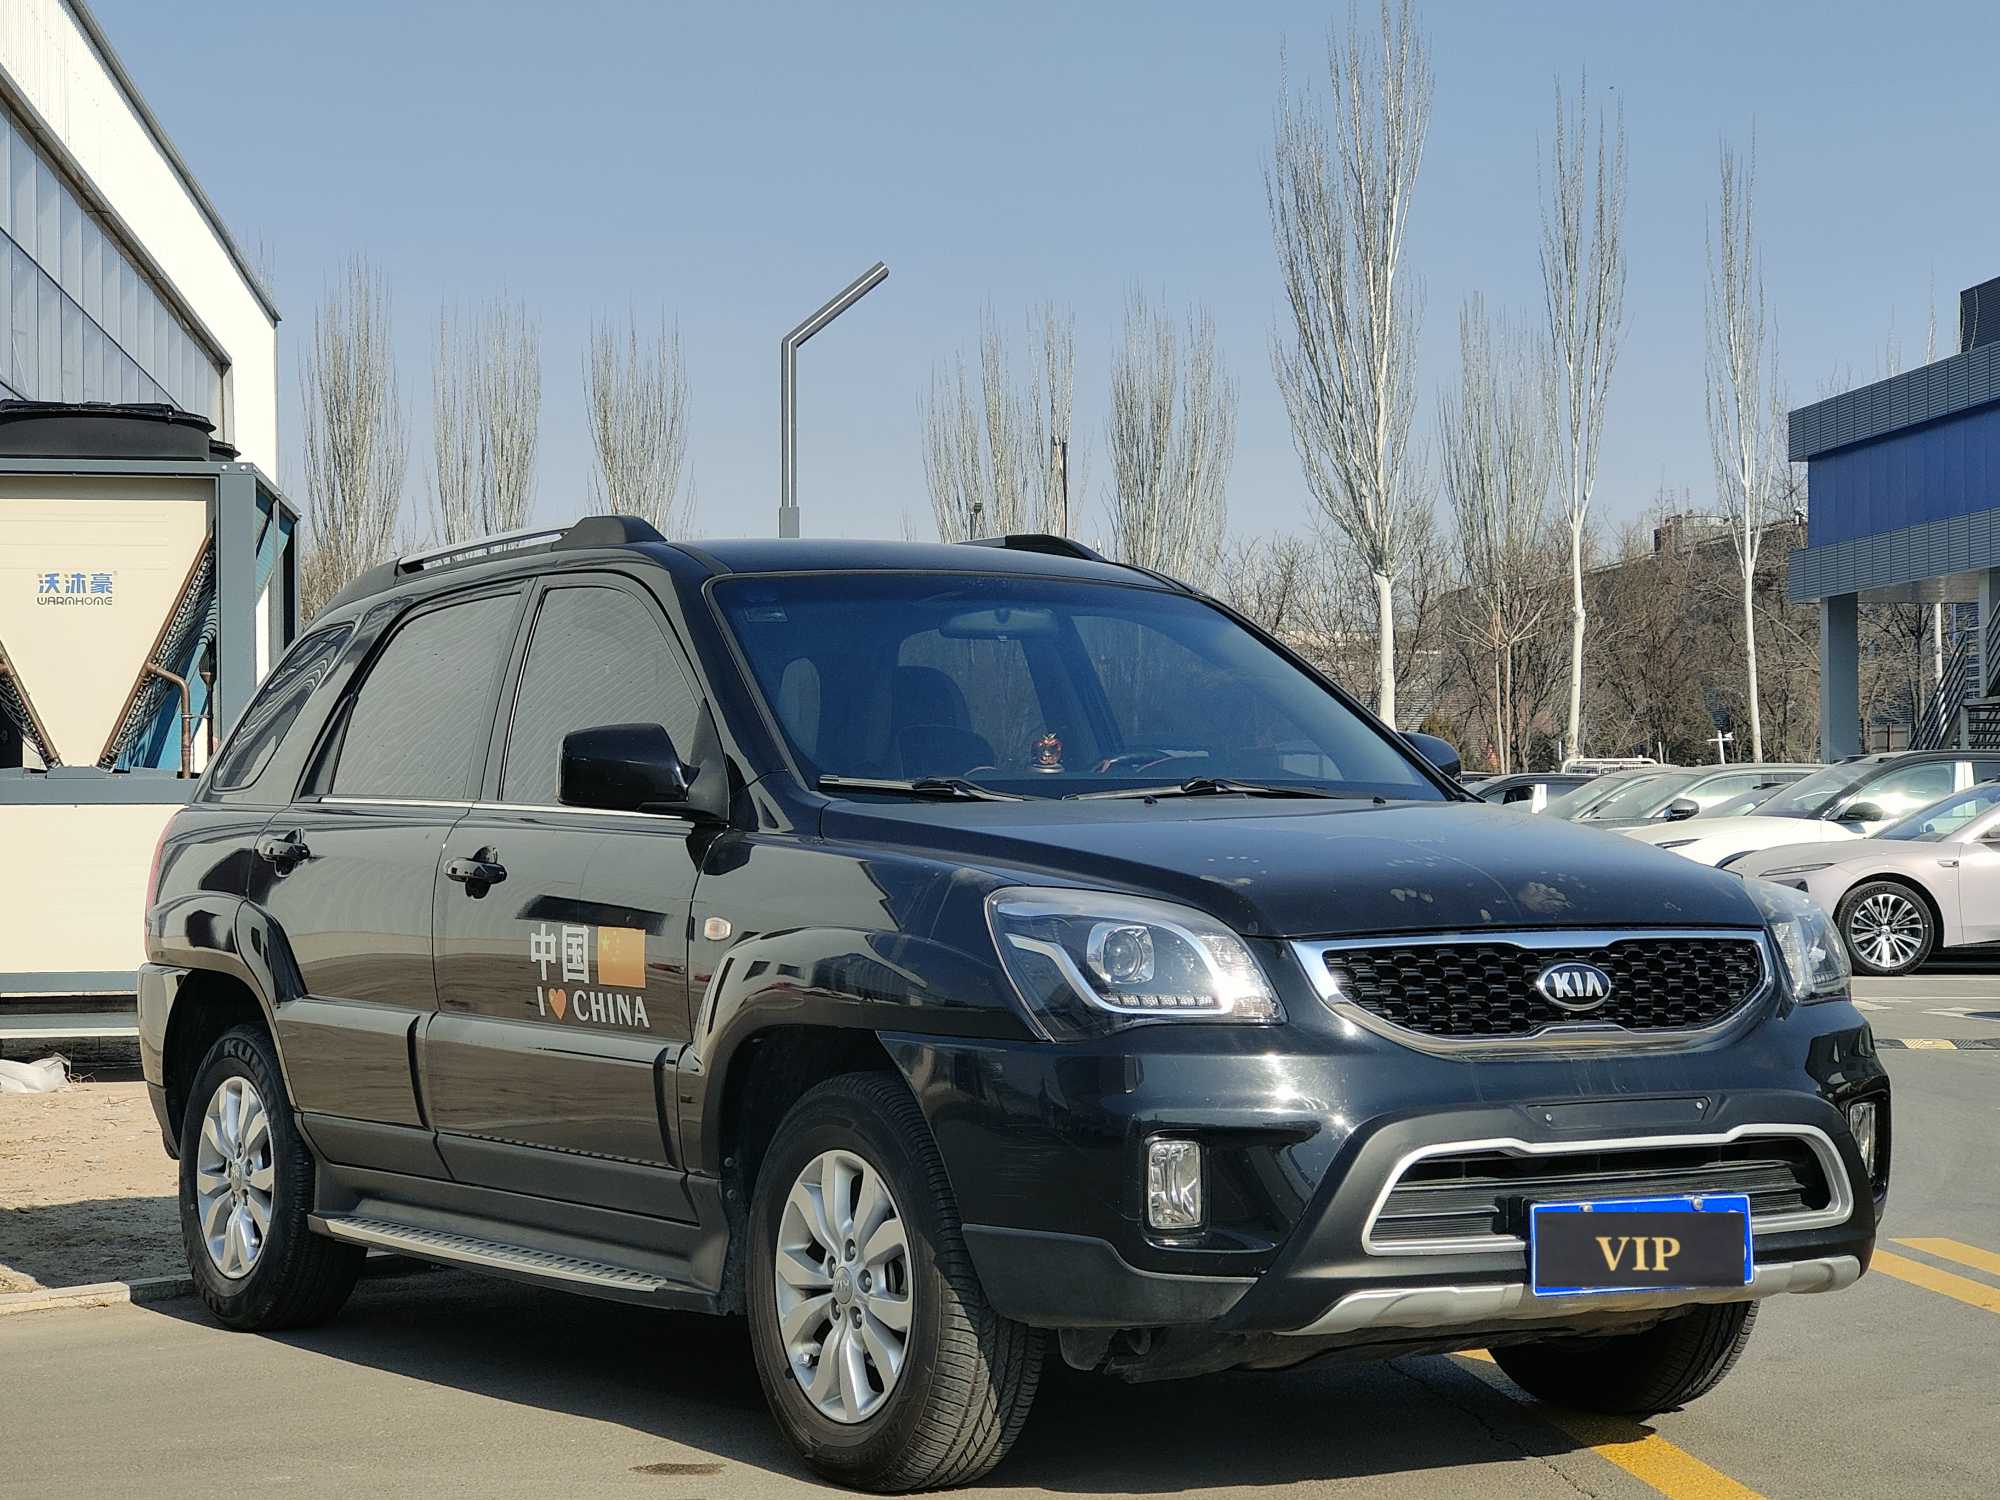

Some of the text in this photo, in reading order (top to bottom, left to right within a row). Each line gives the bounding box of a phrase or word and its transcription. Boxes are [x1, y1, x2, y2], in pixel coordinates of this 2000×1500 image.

[38, 573, 112, 593] 沃沐豪
[36, 596, 112, 605] WARMHOME
[531, 923, 589, 984] 中国
[1551, 972, 1604, 998] KIA
[537, 986, 650, 1028] I CHINA
